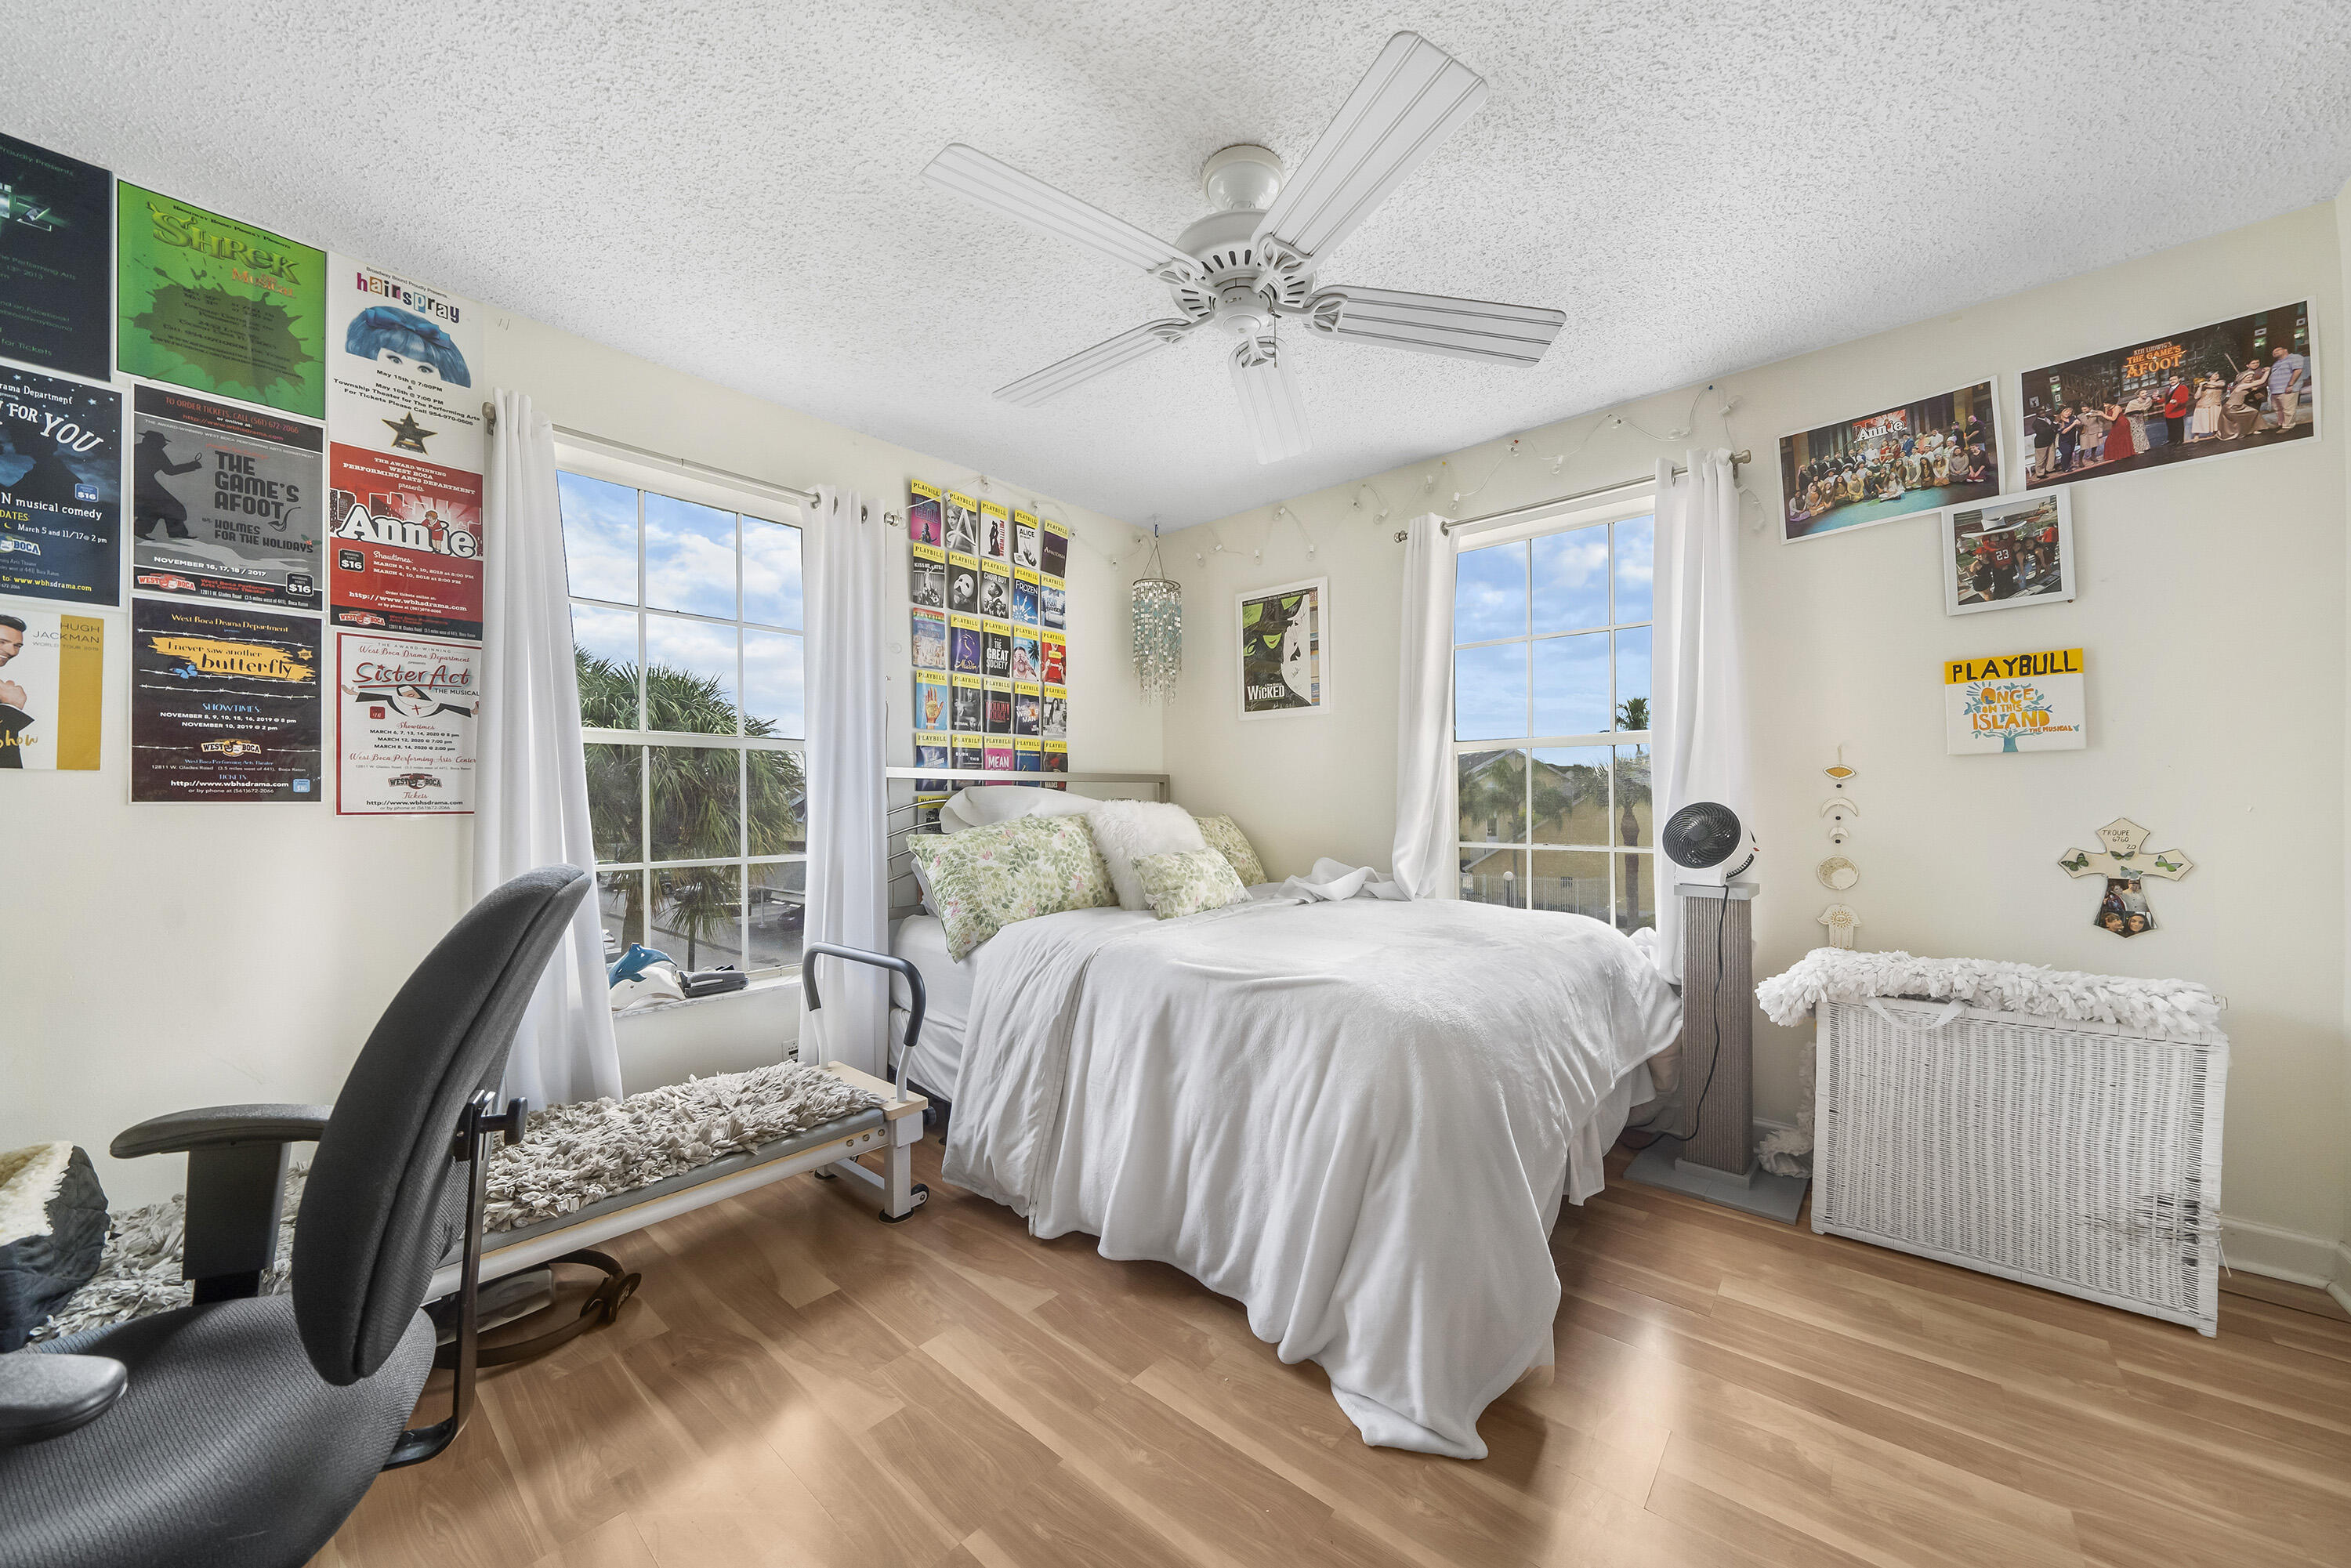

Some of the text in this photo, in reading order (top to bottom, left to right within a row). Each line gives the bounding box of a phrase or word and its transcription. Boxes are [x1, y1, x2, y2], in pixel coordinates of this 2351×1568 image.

[357, 272, 460, 324] hairspray
[2126, 345, 2182, 364] THE GAME'S
[2125, 355, 2182, 378] AFOOT
[376, 369, 443, 392] May 15th 7:00PM
[24, 386, 73, 405] Department
[333, 378, 370, 393] Township
[372, 389, 400, 400] Theater
[428, 404, 465, 418] Performing
[393, 387, 408, 397] 16th
[359, 392, 386, 403] Tickets
[388, 400, 411, 410] Please
[165, 397, 175, 405] TO
[176, 400, 201, 411] ORDER
[233, 411, 248, 422] CALL
[268, 420, 299, 434] 672-2066
[225, 418, 243, 427] online
[9, 402, 104, 453] FOR YOU
[1854, 421, 1905, 443] Annie
[157, 422, 269, 450] AWARD-WINNING PERFORMING
[215, 451, 256, 476] THE
[389, 466, 412, 475] WEST
[390, 461, 447, 476] AWARD-WINNING
[343, 463, 476, 494] PERFORMING ARTS DEPARTMENT
[215, 471, 300, 503] GAME'S
[913, 482, 940, 497] PLAYBILL
[214, 491, 284, 520] AFOOT
[949, 493, 975, 508] PLAYBILL
[16, 498, 103, 520] musical comedy
[983, 503, 1006, 516] PLAYBILL
[1016, 512, 1038, 525] PLAYBILL
[17, 523, 40, 534] March
[214, 519, 261, 535] HOLMES
[336, 504, 477, 558] Annie
[1019, 528, 1035, 538] ALICE
[1046, 522, 1067, 534] PLAYBILL
[13, 540, 39, 554] BOCA
[214, 530, 313, 554] FOR THE HOLIDAYS
[915, 545, 944, 559] PLAYBILL
[1996, 549, 2009, 561] 23
[154, 556, 205, 568] NOVEMBER
[206, 562, 218, 571] 16,
[341, 559, 362, 569] $16
[951, 555, 976, 566] PLAYBILL
[984, 561, 1009, 573] PLAYBILL
[1016, 569, 1038, 581] PLAYBILL
[13, 577, 92, 592] www.wbhsdrama.com
[139, 577, 195, 590] WEST BOCA
[237, 583, 274, 593] Performing
[288, 583, 311, 594] $16
[1016, 580, 1038, 595] FROZEN
[349, 591, 468, 611] http://www.wbhsdrama.com
[60, 622, 100, 634] HUGH
[171, 614, 193, 623] West
[194, 616, 214, 625] Boca
[215, 618, 241, 628] Drama
[242, 621, 288, 632] Department
[370, 617, 385, 625] BOCA
[985, 621, 1010, 632] PLAYBILL
[32, 631, 100, 643] JACKMAN
[1016, 627, 1038, 636] PLAYBILL
[1043, 632, 1065, 642] PLAYBILL
[226, 649, 263, 657] another
[359, 645, 379, 654] West
[429, 653, 470, 663] Department
[987, 648, 1009, 661] GREAT
[201, 654, 292, 678] butterfly
[987, 659, 1009, 670] SOCIETY
[1952, 650, 2078, 682] PLAYBULL
[352, 662, 471, 690] Sister Act
[1981, 686, 2034, 704] ONCE
[1973, 710, 2050, 730] ISLAND
[393, 754, 433, 765] Performing
[988, 756, 1009, 768] MEAN
[390, 778, 442, 787] WEST BOCA
[402, 791, 428, 799] Tickets
